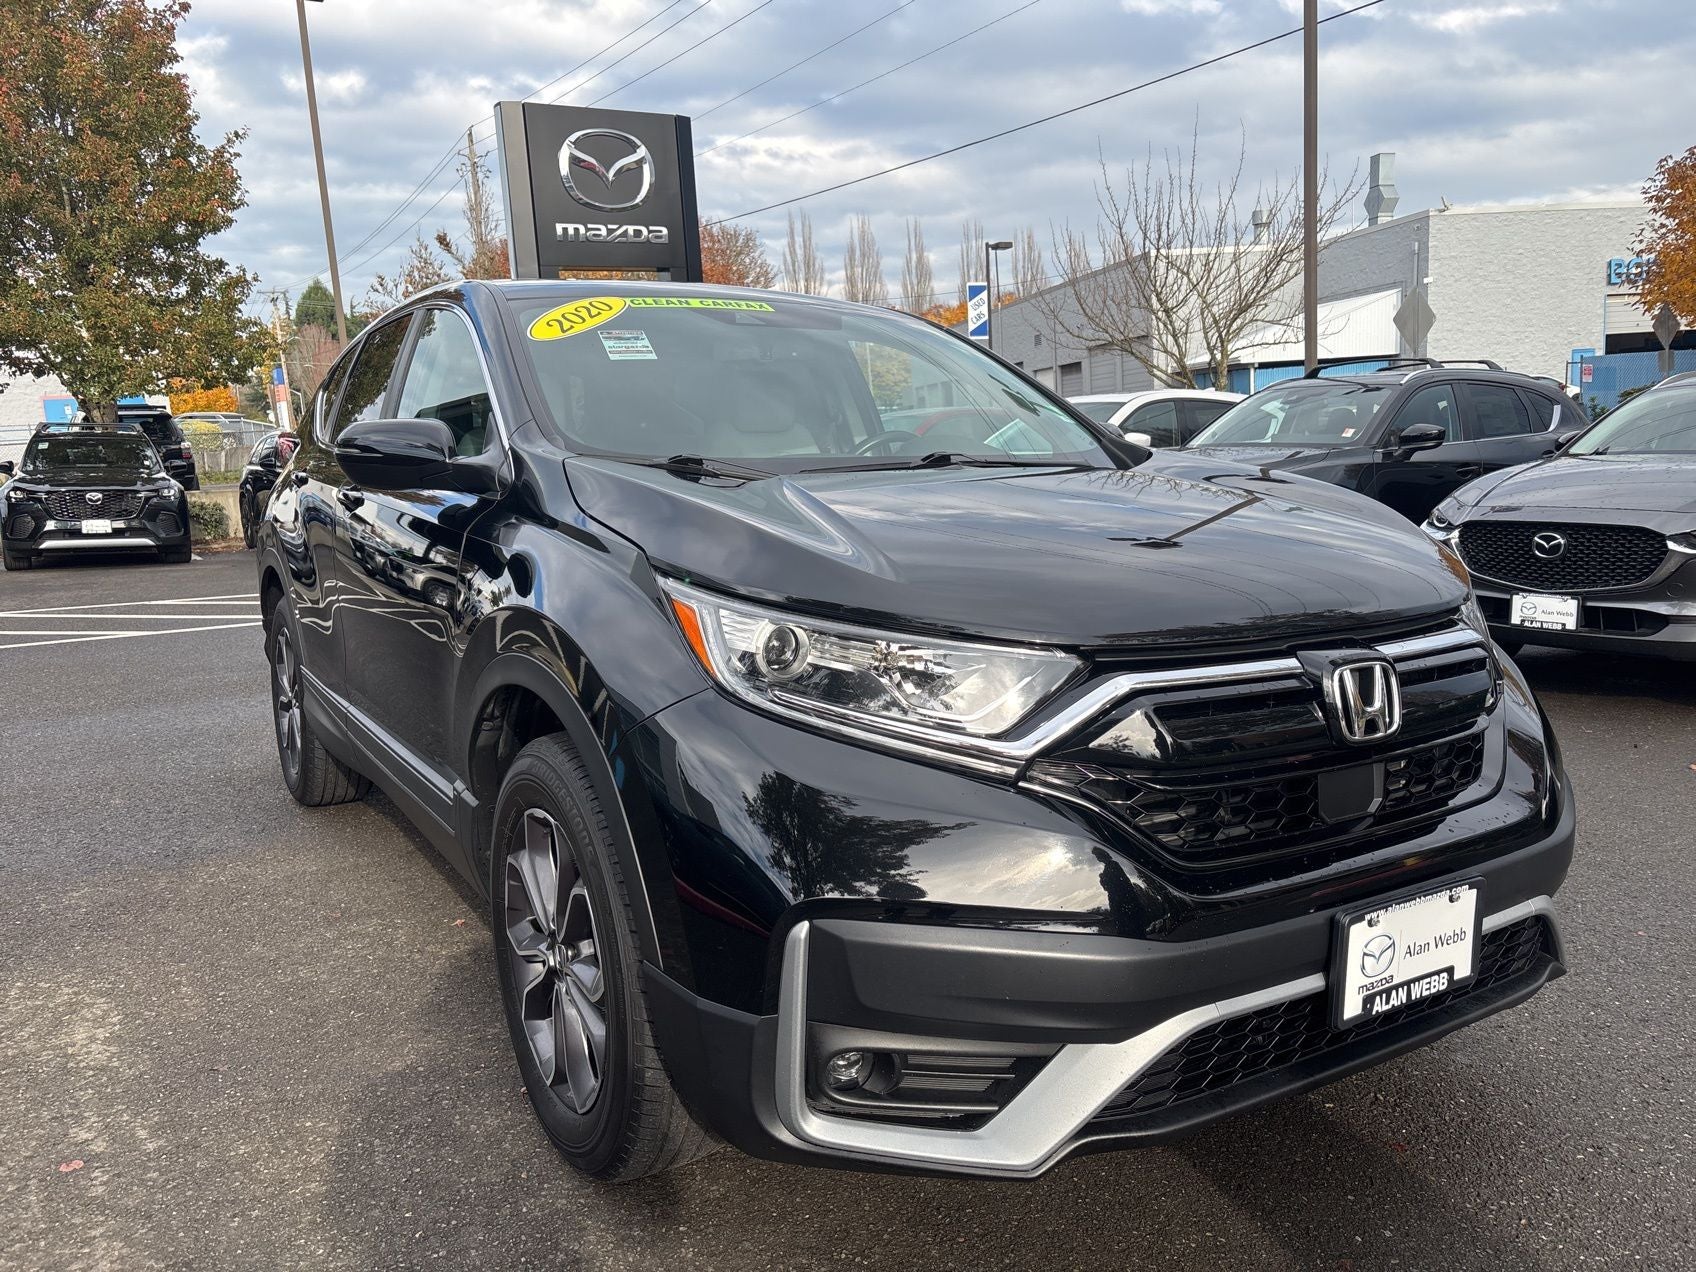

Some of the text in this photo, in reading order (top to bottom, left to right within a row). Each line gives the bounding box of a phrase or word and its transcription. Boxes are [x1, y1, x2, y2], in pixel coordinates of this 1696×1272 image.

[555, 222, 669, 244] mazda
[630, 298, 771, 311] CLEAN CARFAX
[546, 301, 613, 334] 2020
[1556, 610, 1574, 618] Webb
[1542, 622, 1562, 630] WEBB
[1403, 927, 1467, 960] Alan Webb
[1357, 974, 1394, 996] mazda
[1371, 971, 1449, 1016] ALAN WEBB
